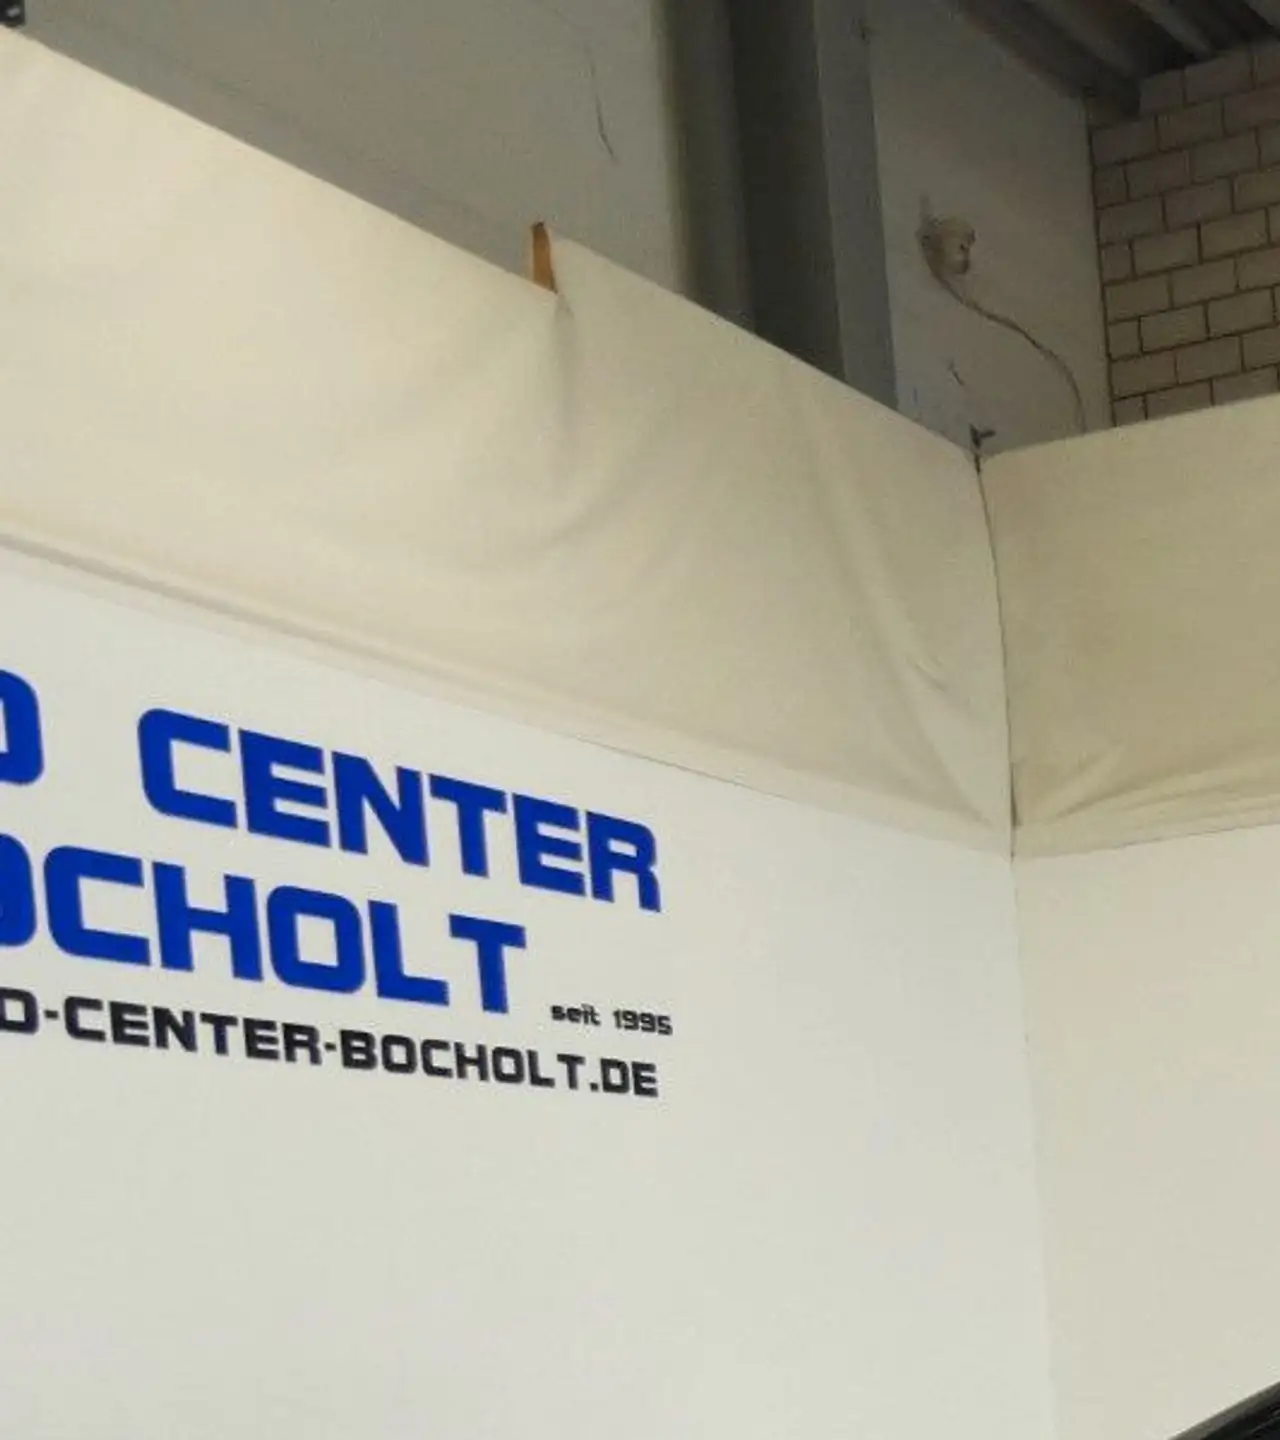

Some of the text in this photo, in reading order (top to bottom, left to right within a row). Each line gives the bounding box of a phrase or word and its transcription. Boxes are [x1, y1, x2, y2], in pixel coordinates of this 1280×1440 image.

[137, 708, 661, 912] CENTER
[550, 1003, 601, 1027] seit
[613, 1009, 673, 1036] 1995
